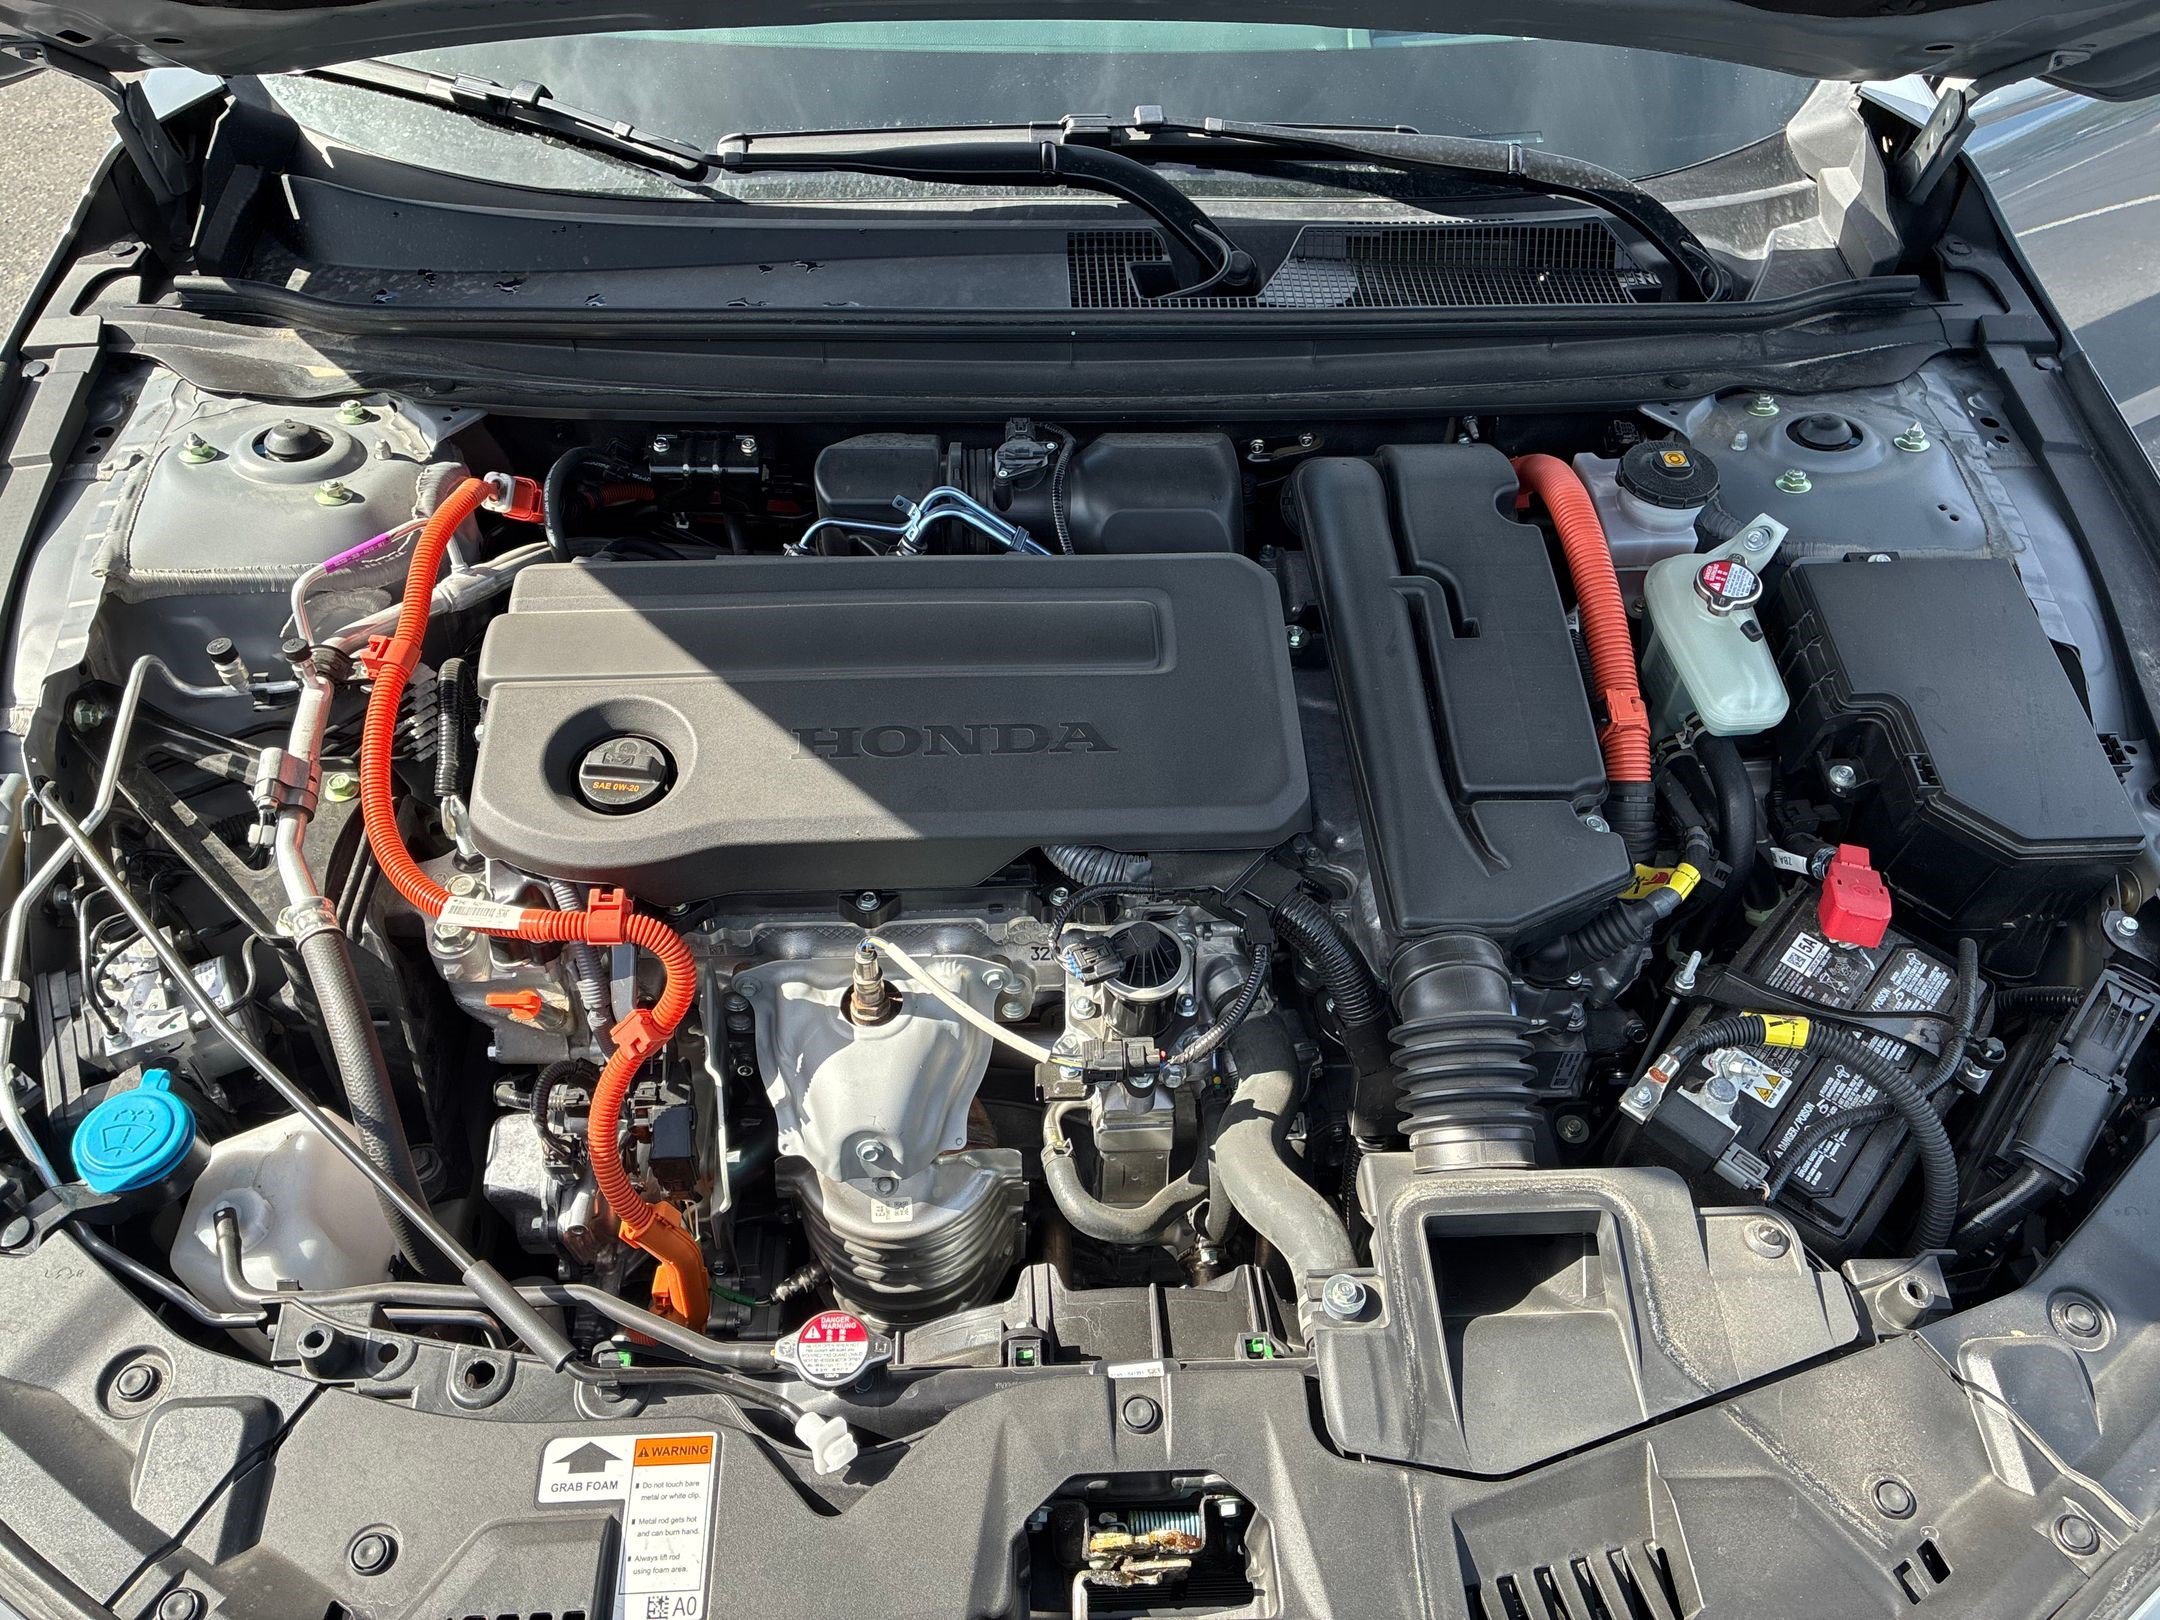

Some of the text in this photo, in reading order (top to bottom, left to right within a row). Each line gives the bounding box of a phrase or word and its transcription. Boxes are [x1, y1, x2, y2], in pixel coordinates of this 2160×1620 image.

[790, 722, 1119, 759] HONDA
[593, 781, 640, 792] SAE 0W-20
[1796, 935, 1818, 954] 5A
[821, 1322, 857, 1330] WARNUNG
[651, 1445, 709, 1457] WARNING
[550, 1480, 619, 1493] GRAB FOAM
[642, 1481, 652, 1489] Do
[665, 1480, 684, 1488] touch
[685, 1480, 700, 1488] bare
[641, 1493, 659, 1501] metal
[669, 1492, 686, 1500] white
[639, 1517, 657, 1525] Metal
[658, 1517, 669, 1525] rod
[671, 1517, 685, 1526] gets
[665, 1528, 680, 1536] burn
[634, 1555, 658, 1563] Always
[669, 1553, 680, 1561] rod
[633, 1567, 651, 1575] using
[652, 1566, 670, 1574] foam
[672, 1596, 697, 1617] A0
